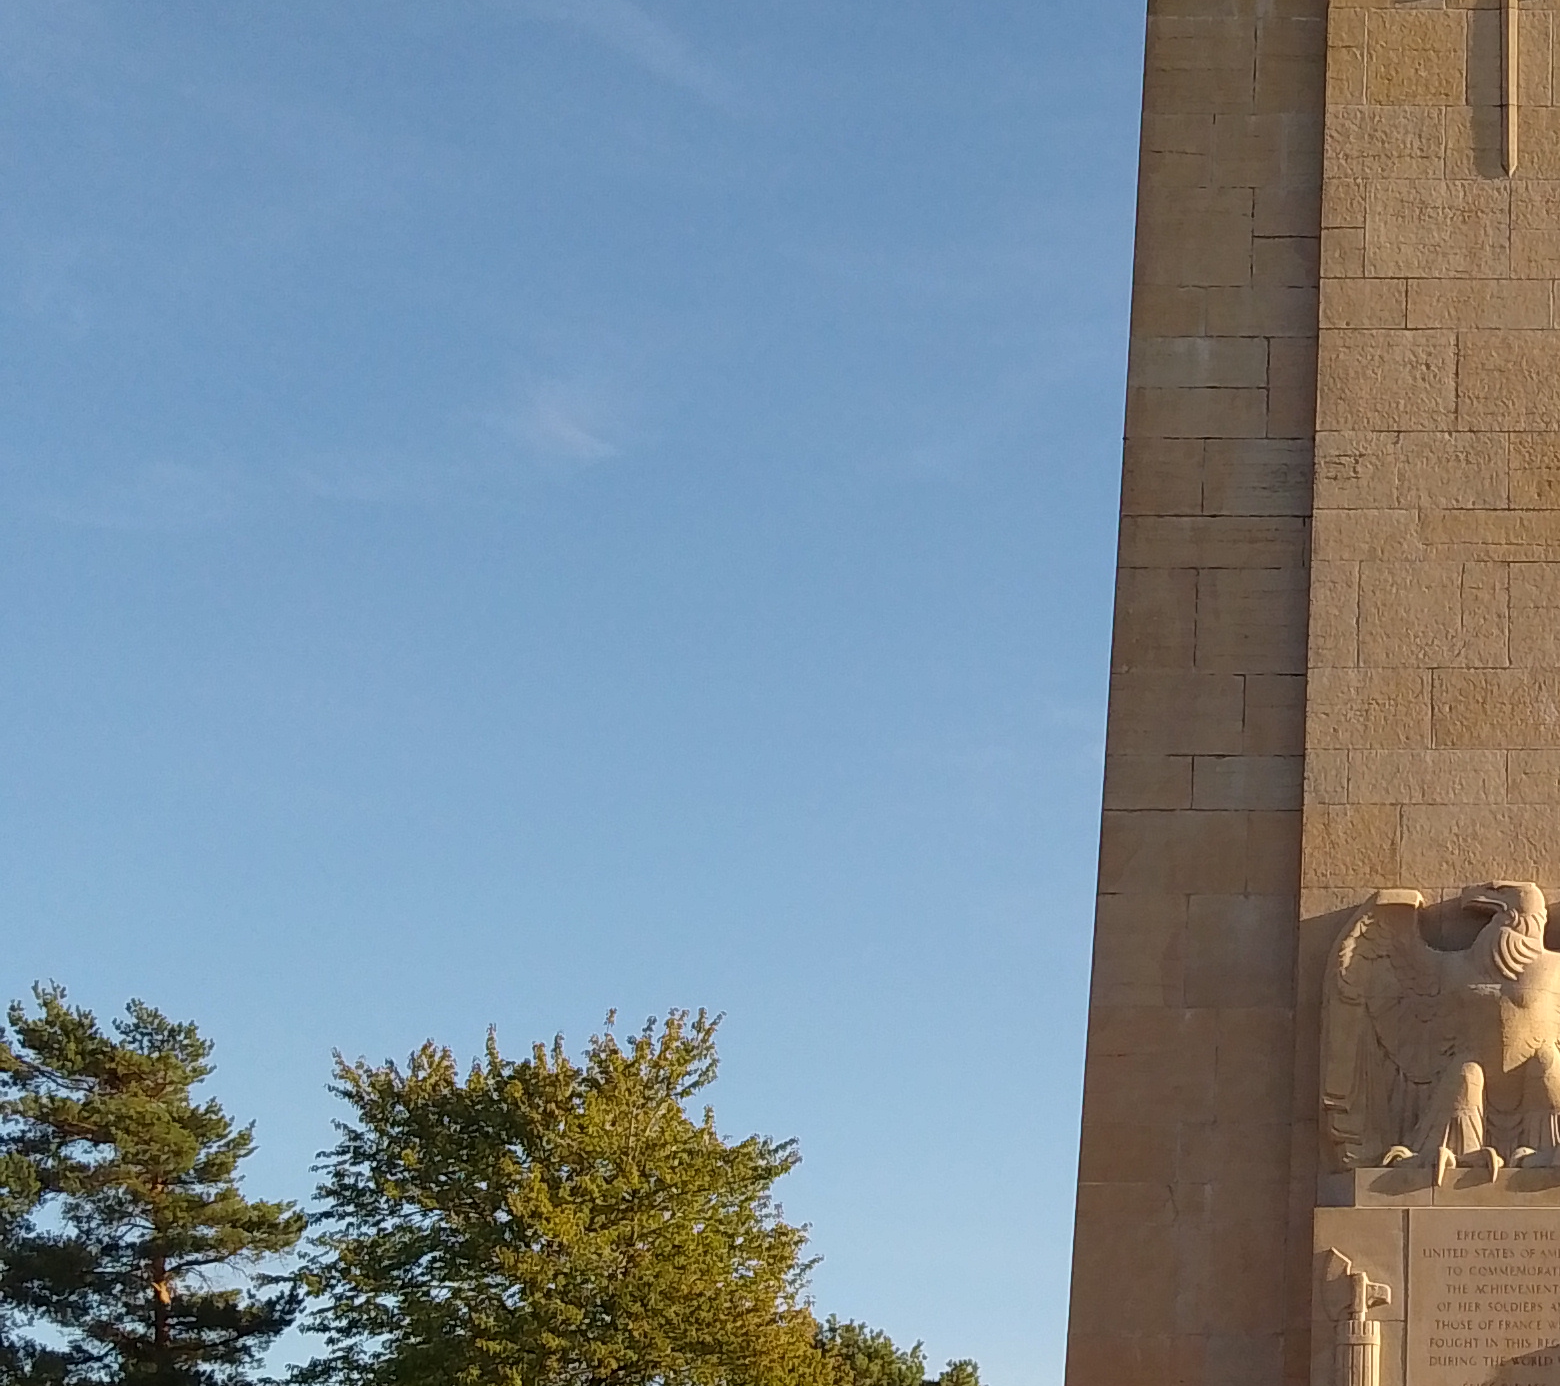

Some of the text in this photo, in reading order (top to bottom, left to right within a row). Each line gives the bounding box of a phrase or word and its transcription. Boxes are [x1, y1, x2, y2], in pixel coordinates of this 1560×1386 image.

[1456, 1230, 1556, 1241] ERECTED BY THE
[1423, 1248, 1467, 1258] UNITED
[1475, 1248, 1515, 1258] STATES
[1520, 1248, 1535, 1258] OF
[1446, 1266, 1462, 1276] TO
[1446, 1284, 1467, 1294] THE
[1437, 1302, 1451, 1312] OF
[1459, 1302, 1481, 1312] HER
[1488, 1302, 1543, 1312] SOLDIERS
[1435, 1320, 1473, 1330] THOSE
[1478, 1320, 1494, 1330] OF
[1499, 1320, 1542, 1330] FRANCE
[1429, 1338, 1479, 1348] FOUGHT
[1486, 1338, 1498, 1348] IN
[1505, 1338, 1531, 1348] THIS
[1429, 1356, 1477, 1366] DURING
[1483, 1356, 1506, 1366] THE
[1512, 1356, 1553, 1366] WORLD
